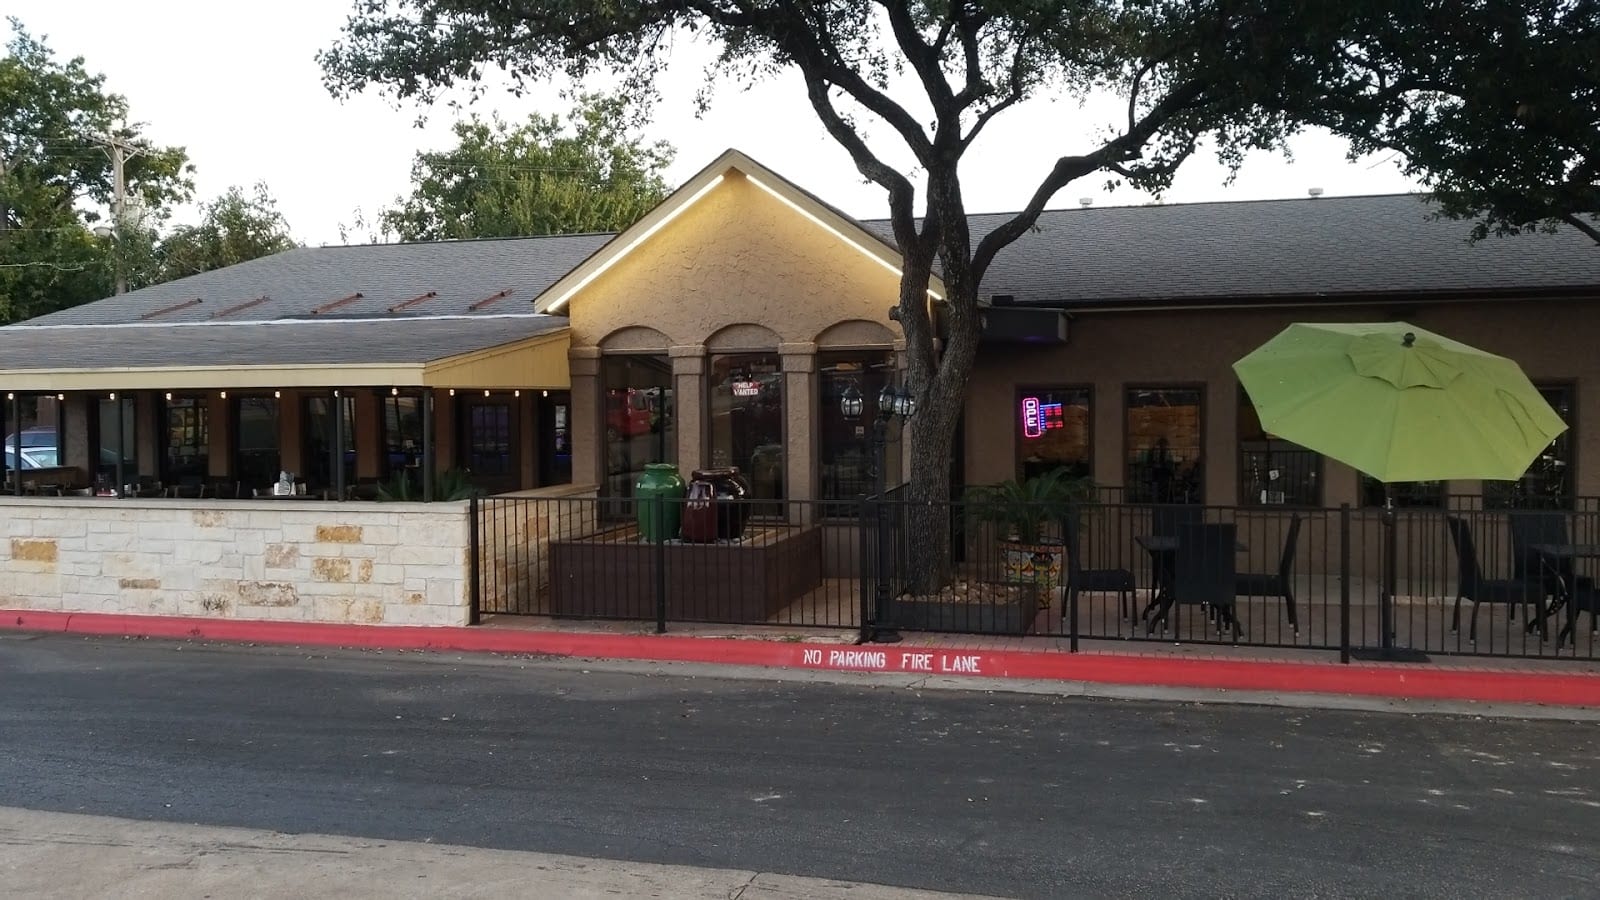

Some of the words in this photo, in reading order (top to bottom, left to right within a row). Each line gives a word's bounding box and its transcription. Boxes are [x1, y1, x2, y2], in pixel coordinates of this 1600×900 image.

[803, 649, 822, 665] NO
[829, 650, 886, 669] PARKING
[901, 653, 934, 671] FIRE
[942, 655, 981, 673] LANE
